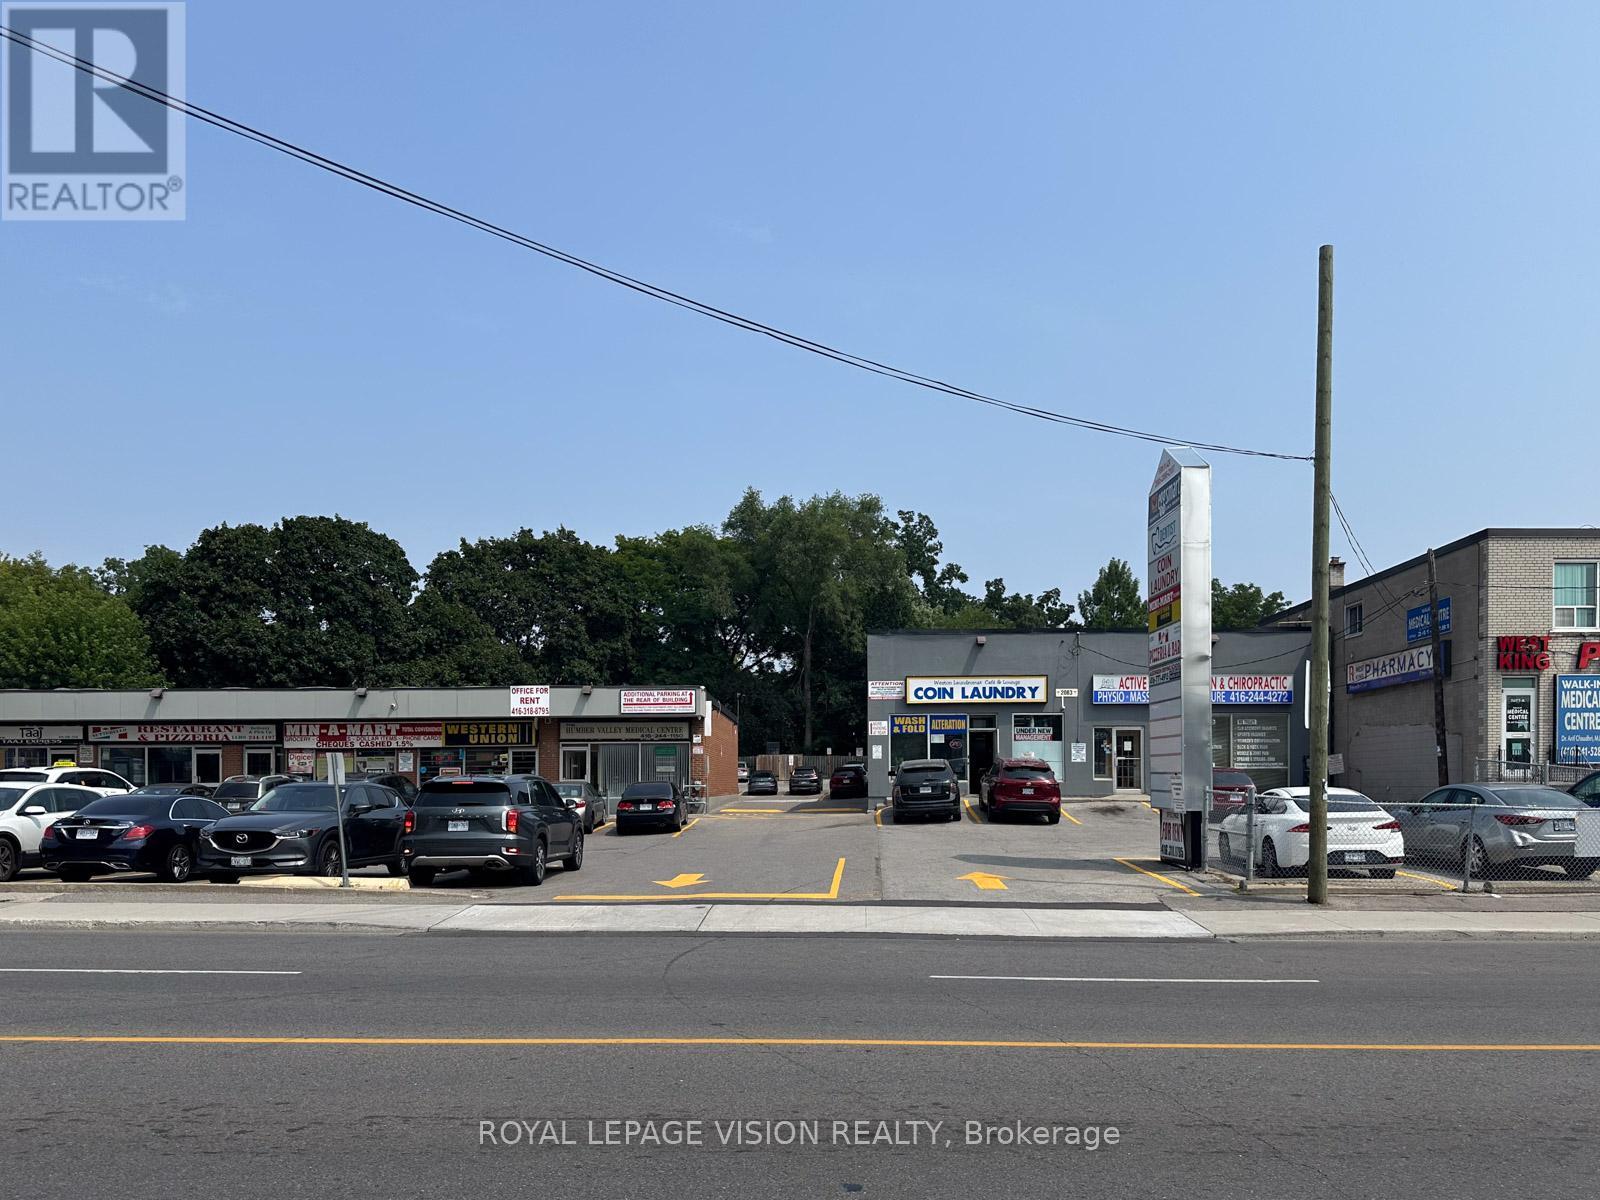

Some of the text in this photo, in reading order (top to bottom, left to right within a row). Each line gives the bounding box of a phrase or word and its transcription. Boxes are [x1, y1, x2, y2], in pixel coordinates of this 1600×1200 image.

[1157, 554, 1171, 573] COIN
[1151, 568, 1178, 594] LAUNDRY
[1499, 636, 1551, 652] WEST
[1364, 649, 1433, 679] PHARMACY
[1499, 653, 1551, 671] KING
[1118, 676, 1147, 690] ACTIVE
[1219, 677, 1225, 689] &
[1227, 676, 1288, 690] CHIROPRACTIC
[913, 687, 954, 699] COIN
[961, 686, 1040, 699] LAUNDRY
[1097, 691, 1125, 702] PHYSIO
[1229, 691, 1289, 702] 416-244-4272
[1561, 690, 1600, 708] MEDICA
[511, 707, 549, 715] 416-318-8795
[894, 716, 926, 725] WASH
[931, 719, 966, 730] ALTERATION
[1564, 712, 1600, 730] CENTRE
[19, 726, 43, 739] Taaj
[137, 725, 245, 733] RESTAURANT
[286, 725, 400, 736] MIN-A-MART
[447, 724, 518, 734] WESTERN
[893, 725, 925, 733] & FOLD
[137, 733, 149, 741] &
[154, 733, 231, 741] PIZZERIA
[468, 734, 518, 743] UNION
